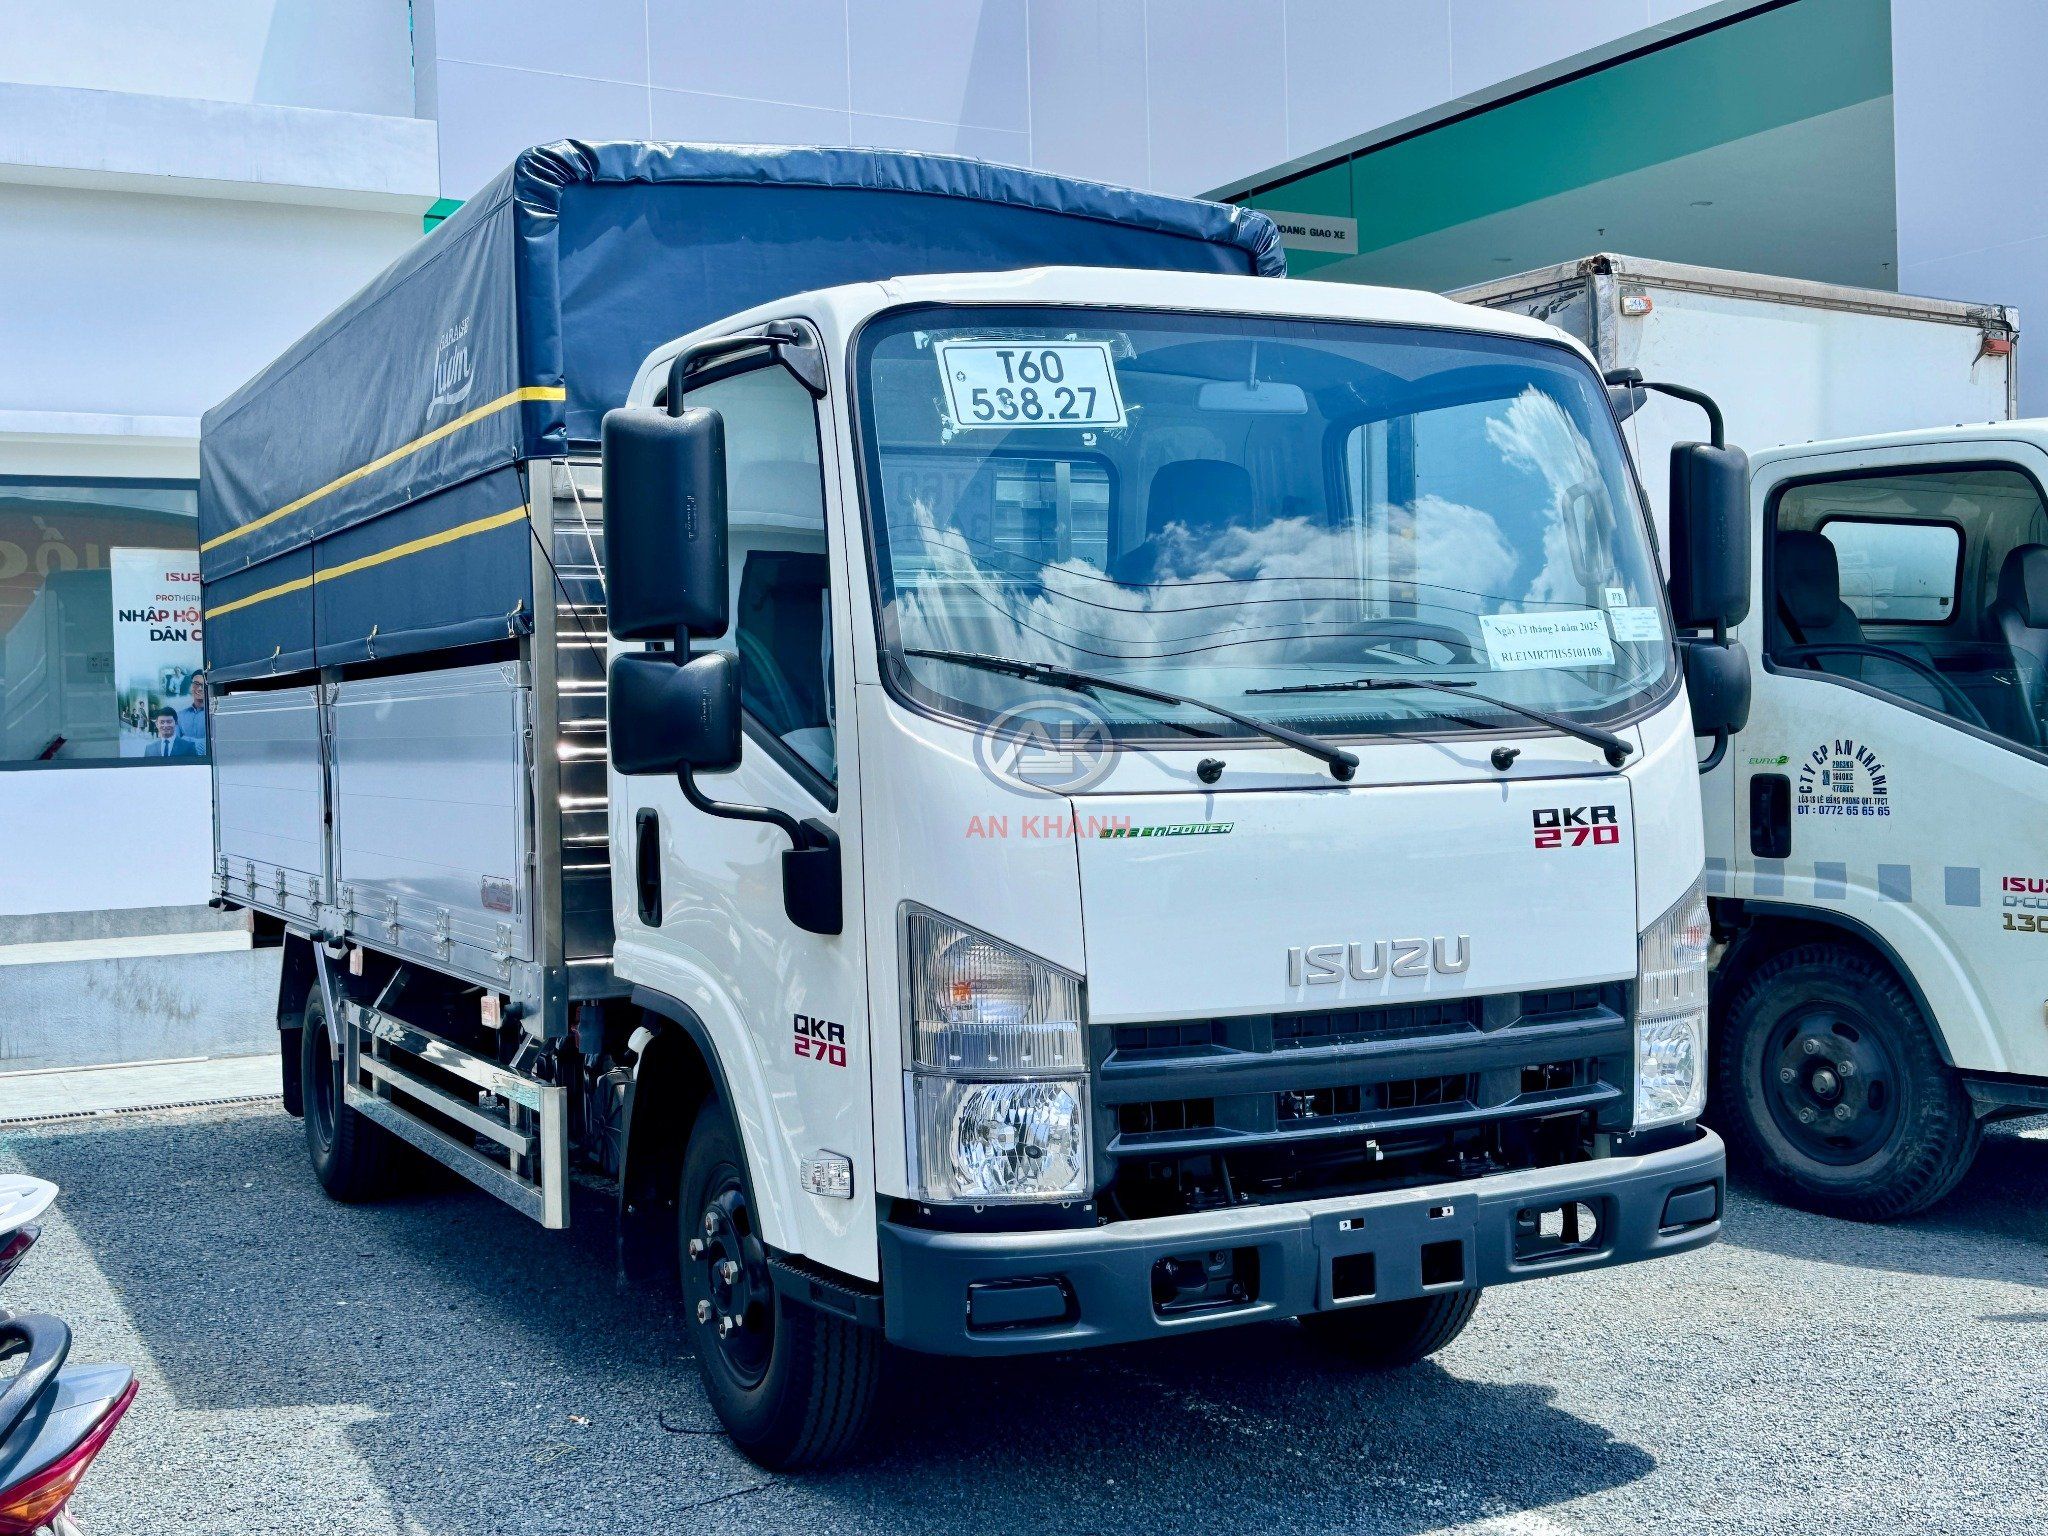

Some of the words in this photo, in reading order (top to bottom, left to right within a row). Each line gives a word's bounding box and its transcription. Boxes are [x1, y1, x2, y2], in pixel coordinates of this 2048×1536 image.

[1310, 228, 1331, 238] GIAO
[1333, 230, 1346, 240] XE
[996, 350, 1064, 384] T60
[971, 386, 1098, 422] 538.27
[119, 606, 169, 625] NHẬP
[150, 626, 187, 642] DÂN
[1530, 624, 1553, 635] tháng
[1580, 621, 1599, 632] 2025
[1799, 763, 1816, 794] CTY
[1812, 744, 1828, 765] CP
[1835, 739, 1853, 756] AN
[1855, 744, 1888, 795] KHÁNH
[1532, 805, 1618, 827] QKR
[1818, 805, 1843, 815] 0772
[1846, 806, 1859, 816] 65
[1862, 806, 1874, 816] 65
[1877, 806, 1891, 816] 65
[1533, 825, 1620, 849] 270
[2003, 876, 2048, 893] ISU
[1288, 934, 1471, 987] ISUZU
[794, 1013, 846, 1045] QKR
[794, 1034, 847, 1068] 270
